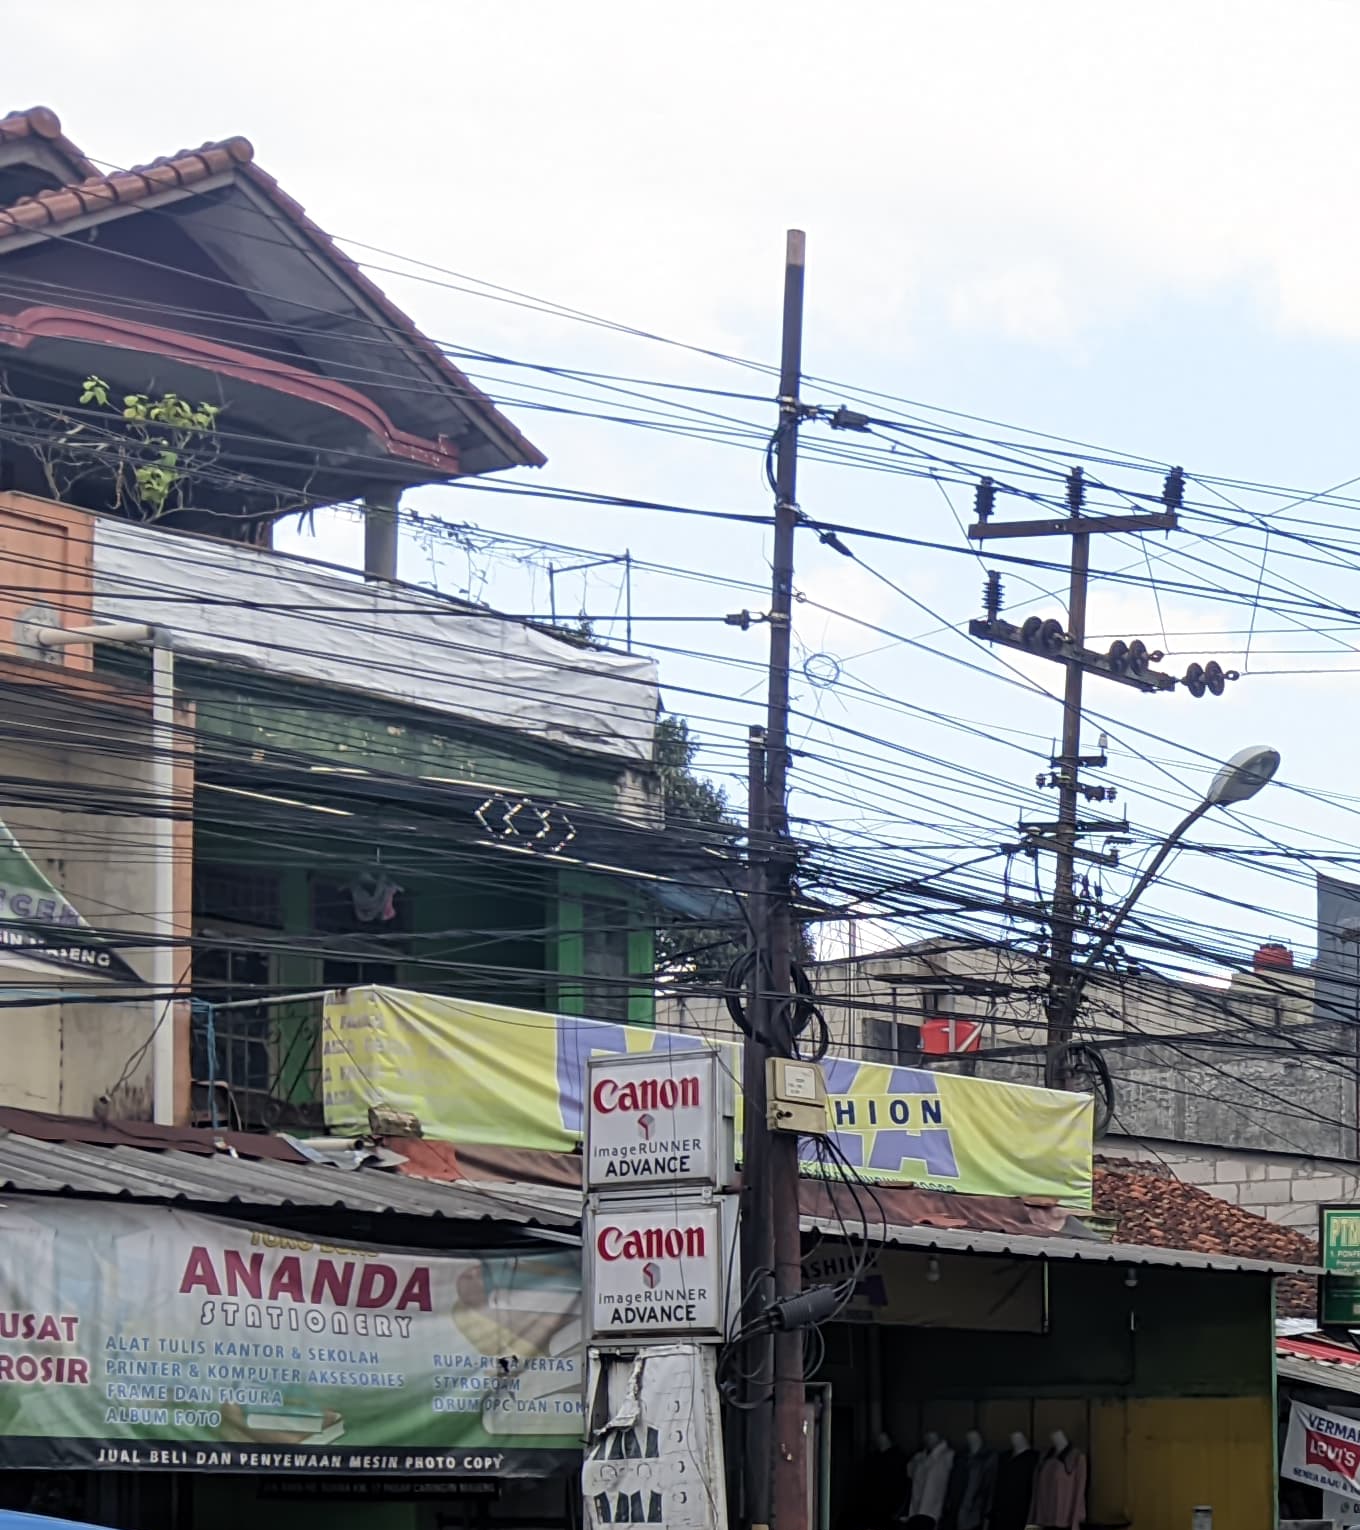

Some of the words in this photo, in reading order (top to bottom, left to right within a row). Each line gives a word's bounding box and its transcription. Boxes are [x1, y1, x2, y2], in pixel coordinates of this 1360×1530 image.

[593, 1076, 700, 1114] Canon
[834, 1099, 942, 1126] HION
[593, 1138, 702, 1158] imageRUNNER
[605, 1155, 691, 1177] ADVANCE
[597, 1226, 705, 1261] Canon
[179, 1246, 433, 1312] ANANDA
[598, 1288, 707, 1306] imageRUNNER
[200, 1300, 413, 1339] STATIONERY
[610, 1304, 697, 1325] ADVANCE
[105, 1336, 150, 1352] ALAT
[159, 1338, 206, 1355] TULIS
[214, 1341, 285, 1359] KANTOR
[291, 1347, 301, 1360] &
[308, 1347, 379, 1365] SEKOLAH
[106, 1360, 181, 1377] PRINTER
[188, 1364, 200, 1378] &
[207, 1365, 300, 1383] KOMPUTER
[308, 1369, 405, 1388] AKSESORIES
[106, 1383, 167, 1400] FRAME
[175, 1386, 212, 1402] DAN
[219, 1387, 283, 1406] FIGURA
[432, 1396, 481, 1413] DRUM
[516, 1399, 547, 1413] DAN
[106, 1407, 167, 1424] ALBUM
[175, 1409, 221, 1427] FOTO
[98, 1449, 141, 1464] JUAL
[150, 1449, 188, 1465] BELI
[196, 1451, 231, 1466] DAN
[240, 1452, 342, 1468] PENYEWAAN
[348, 1455, 398, 1469] MESIN
[404, 1455, 456, 1470] PHOTO
[463, 1455, 503, 1470] COPY
